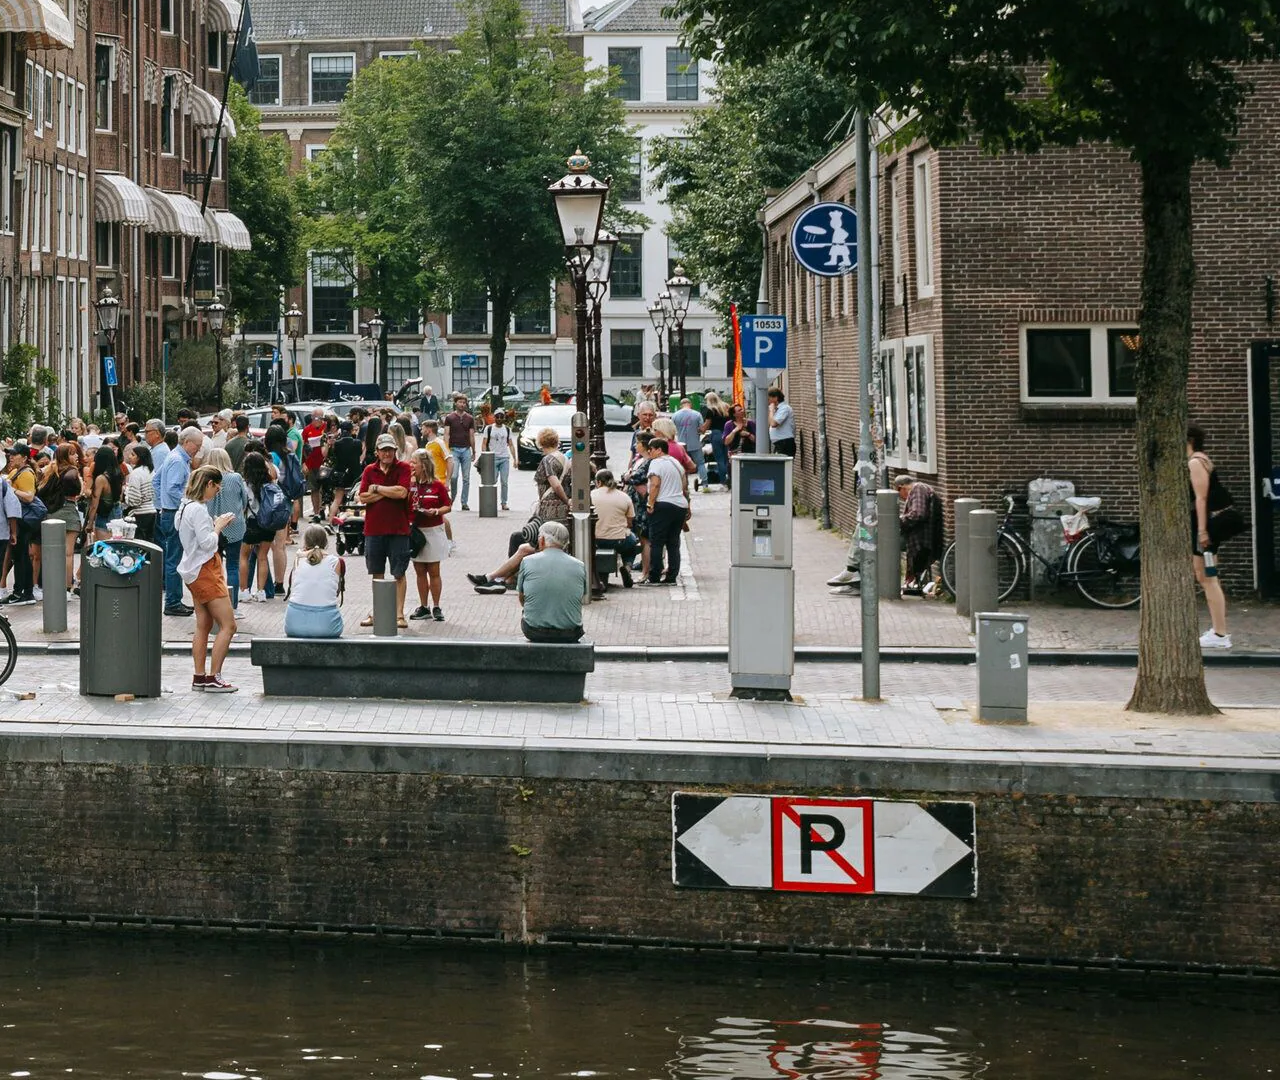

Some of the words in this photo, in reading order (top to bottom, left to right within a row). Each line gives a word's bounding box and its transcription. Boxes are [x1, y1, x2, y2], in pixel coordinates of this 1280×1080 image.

[755, 320, 782, 329] 10533
[755, 336, 773, 363] P
[799, 813, 846, 875] P
